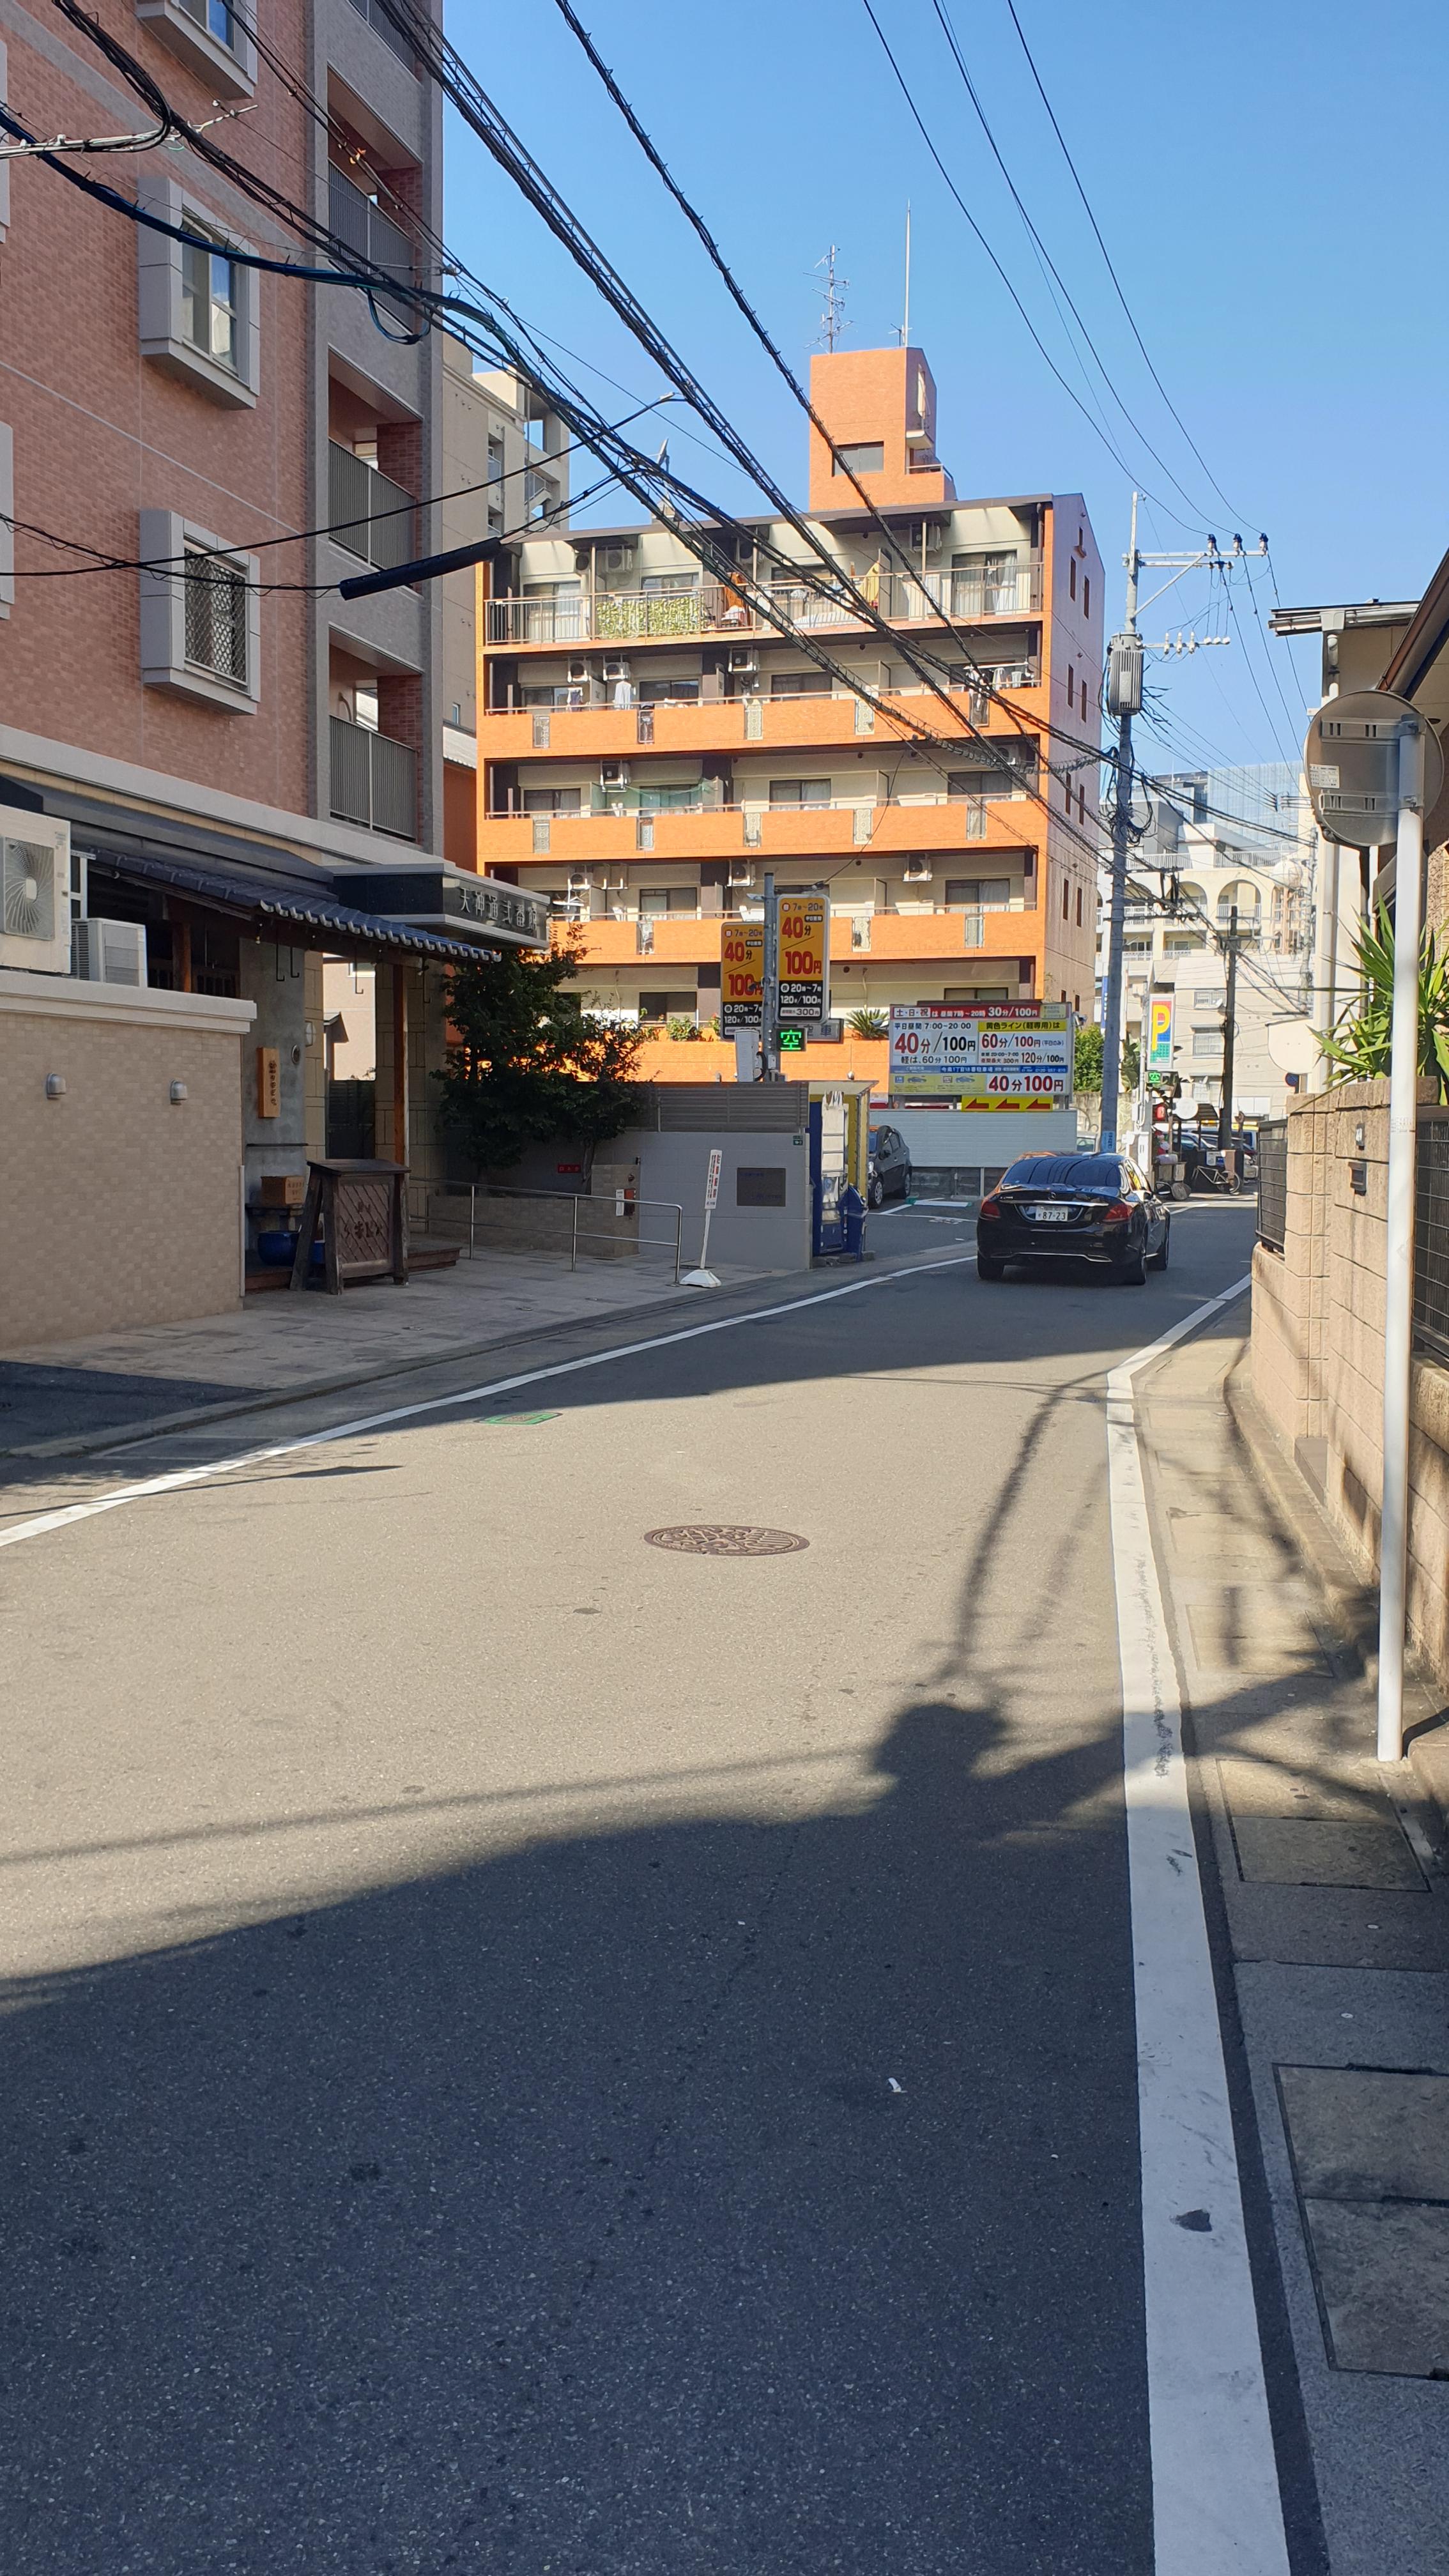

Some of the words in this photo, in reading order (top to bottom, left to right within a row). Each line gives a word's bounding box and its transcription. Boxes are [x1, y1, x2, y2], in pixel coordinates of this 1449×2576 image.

[781, 916, 811, 939] 40分
[785, 951, 822, 975] 100円
[780, 1029, 802, 1050] 空
[1151, 1004, 1171, 1052] P
